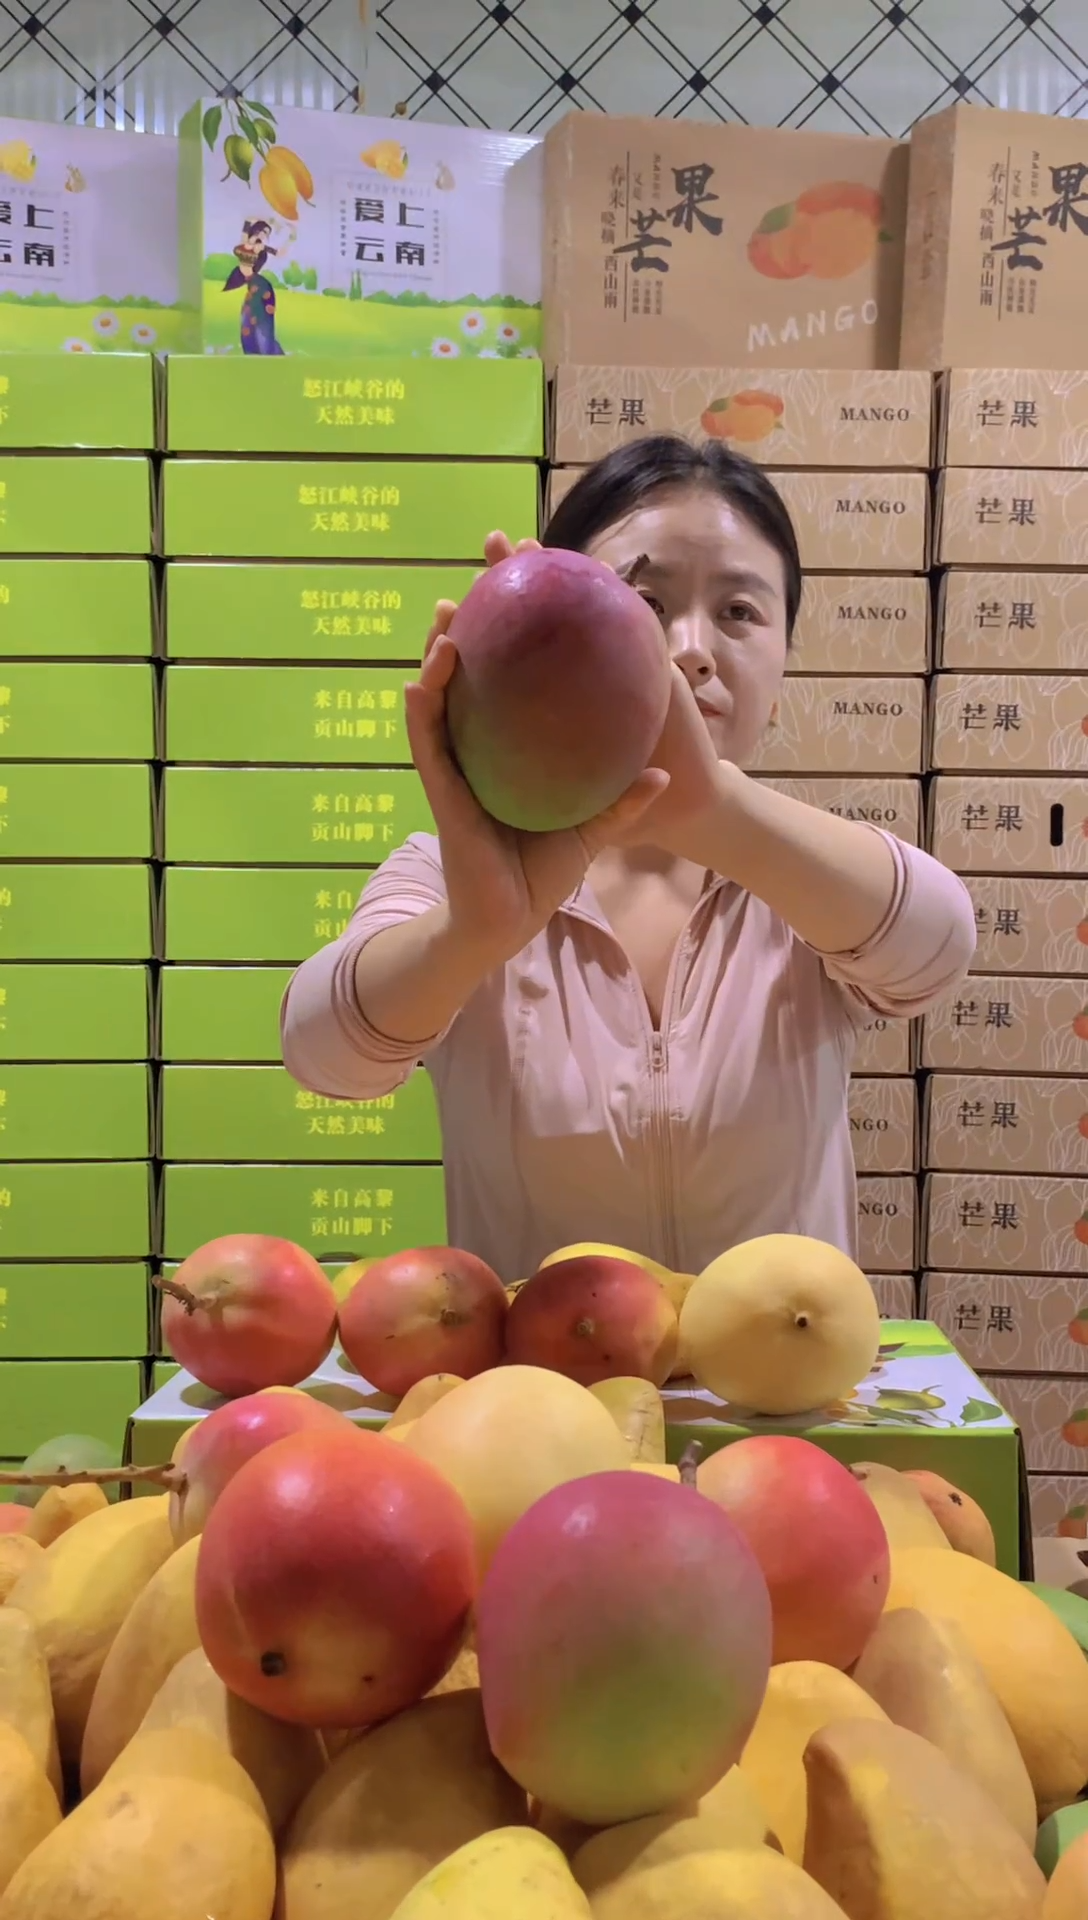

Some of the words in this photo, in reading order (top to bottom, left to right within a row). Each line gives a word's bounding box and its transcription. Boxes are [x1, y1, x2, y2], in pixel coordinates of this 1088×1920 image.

[355, 197, 425, 229] 爱上
[355, 236, 425, 267] 云南
[747, 298, 878, 353] MANGO
[303, 378, 405, 400] 怒江峡谷的
[317, 405, 395, 426] 天然美味
[586, 397, 646, 427] 芒果
[840, 407, 910, 422] MANGO
[977, 399, 1039, 428] 芒果
[298, 485, 400, 506] 怒江峡谷的
[835, 499, 906, 514] MANGO
[975, 497, 1037, 526] 芒果
[311, 511, 390, 532] 天然美味
[300, 589, 402, 610] 怒江峡谷的
[837, 606, 907, 620] MANGO
[975, 602, 1037, 630] 芒果
[313, 616, 392, 636] 天然美味
[314, 689, 398, 710] 来自高黎
[833, 701, 903, 716] MANGO
[314, 718, 397, 738] 贡山脚下
[961, 703, 1021, 732] 芒果
[312, 793, 395, 813] 来自高黎
[961, 804, 1023, 832] 芒果
[311, 822, 394, 842] 贡山脚下
[314, 889, 352, 910] 来自
[951, 1000, 1013, 1029] 芒果
[308, 1115, 385, 1135] 天然美味
[849, 1118, 889, 1132] NGO
[958, 1101, 1019, 1129] 芒果
[311, 1189, 394, 1208] 来自高黎
[858, 1202, 898, 1216] NGO
[958, 1200, 1019, 1230] 芒果
[311, 1217, 393, 1236] 贡山脚下
[954, 1304, 1014, 1333] 芒果
